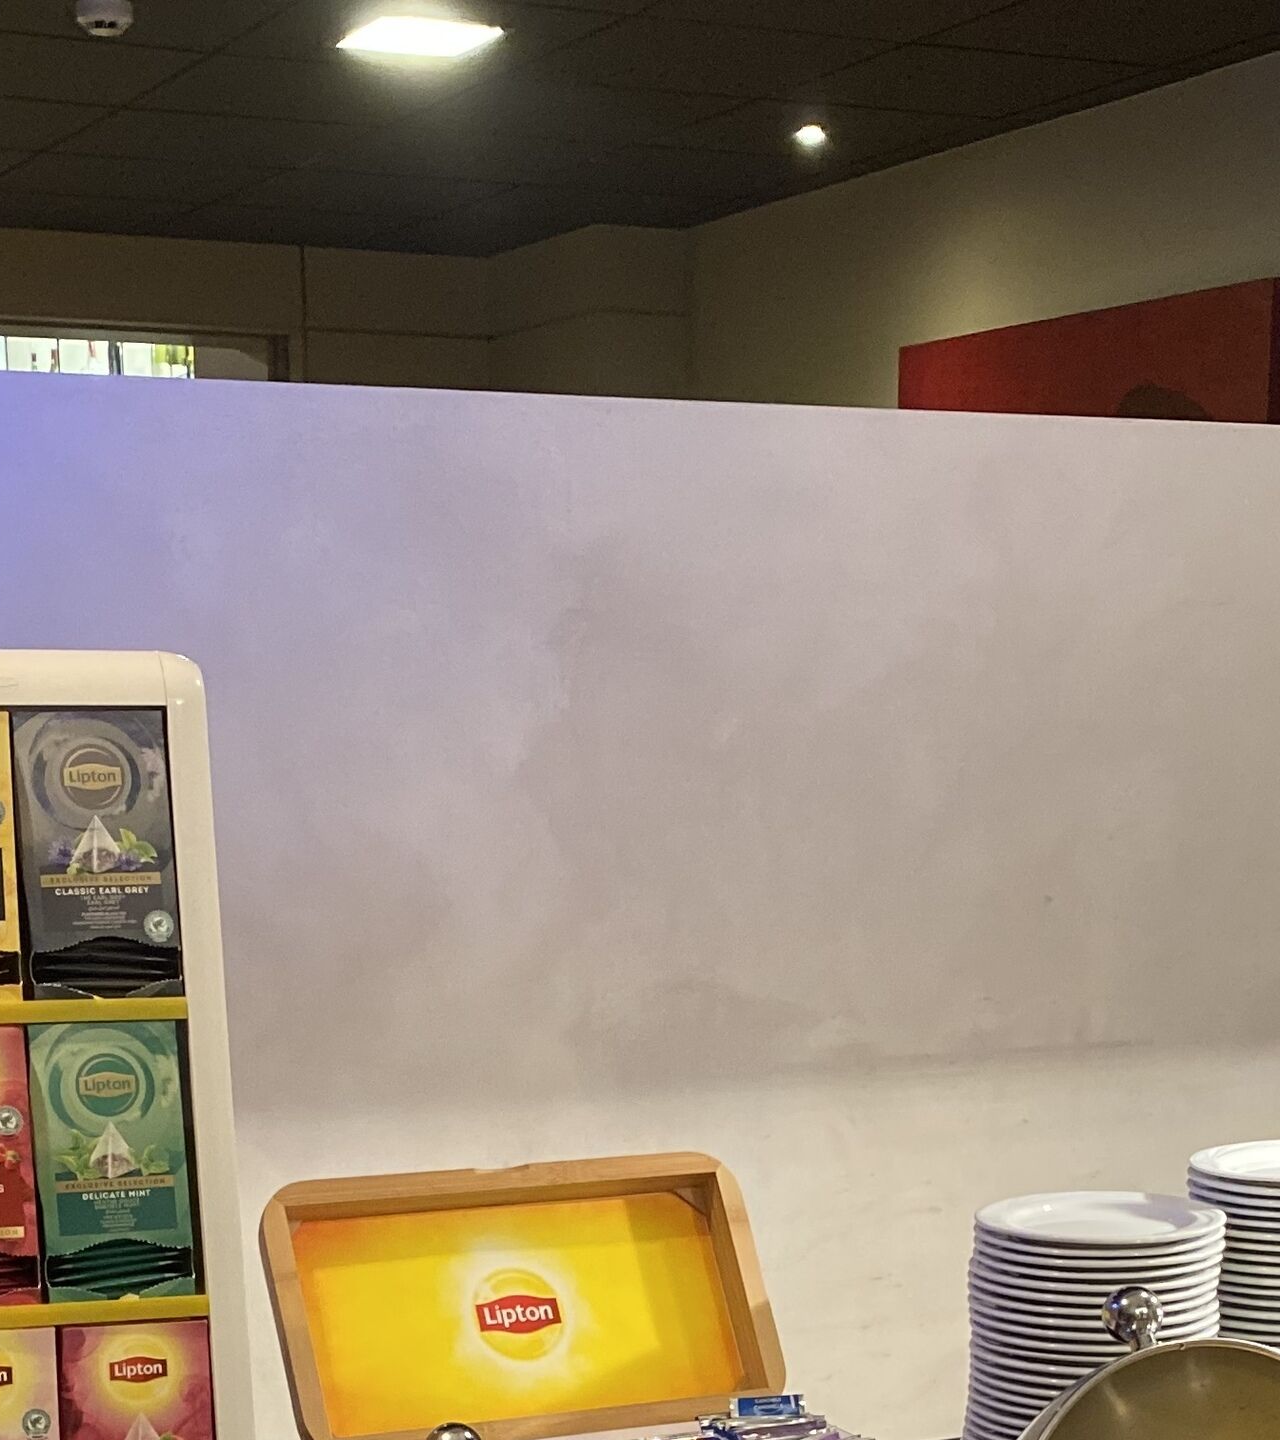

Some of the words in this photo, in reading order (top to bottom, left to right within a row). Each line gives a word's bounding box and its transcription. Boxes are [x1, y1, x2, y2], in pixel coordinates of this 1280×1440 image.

[69, 770, 116, 784] Lipton
[55, 887, 96, 896] CLASSIC
[125, 886, 149, 894] GREY
[84, 1079, 131, 1094] Lipton
[82, 1190, 126, 1200] DELICATE
[128, 1189, 151, 1198] MINT
[483, 1304, 554, 1328] Lipton
[114, 1362, 163, 1379] Lipton
